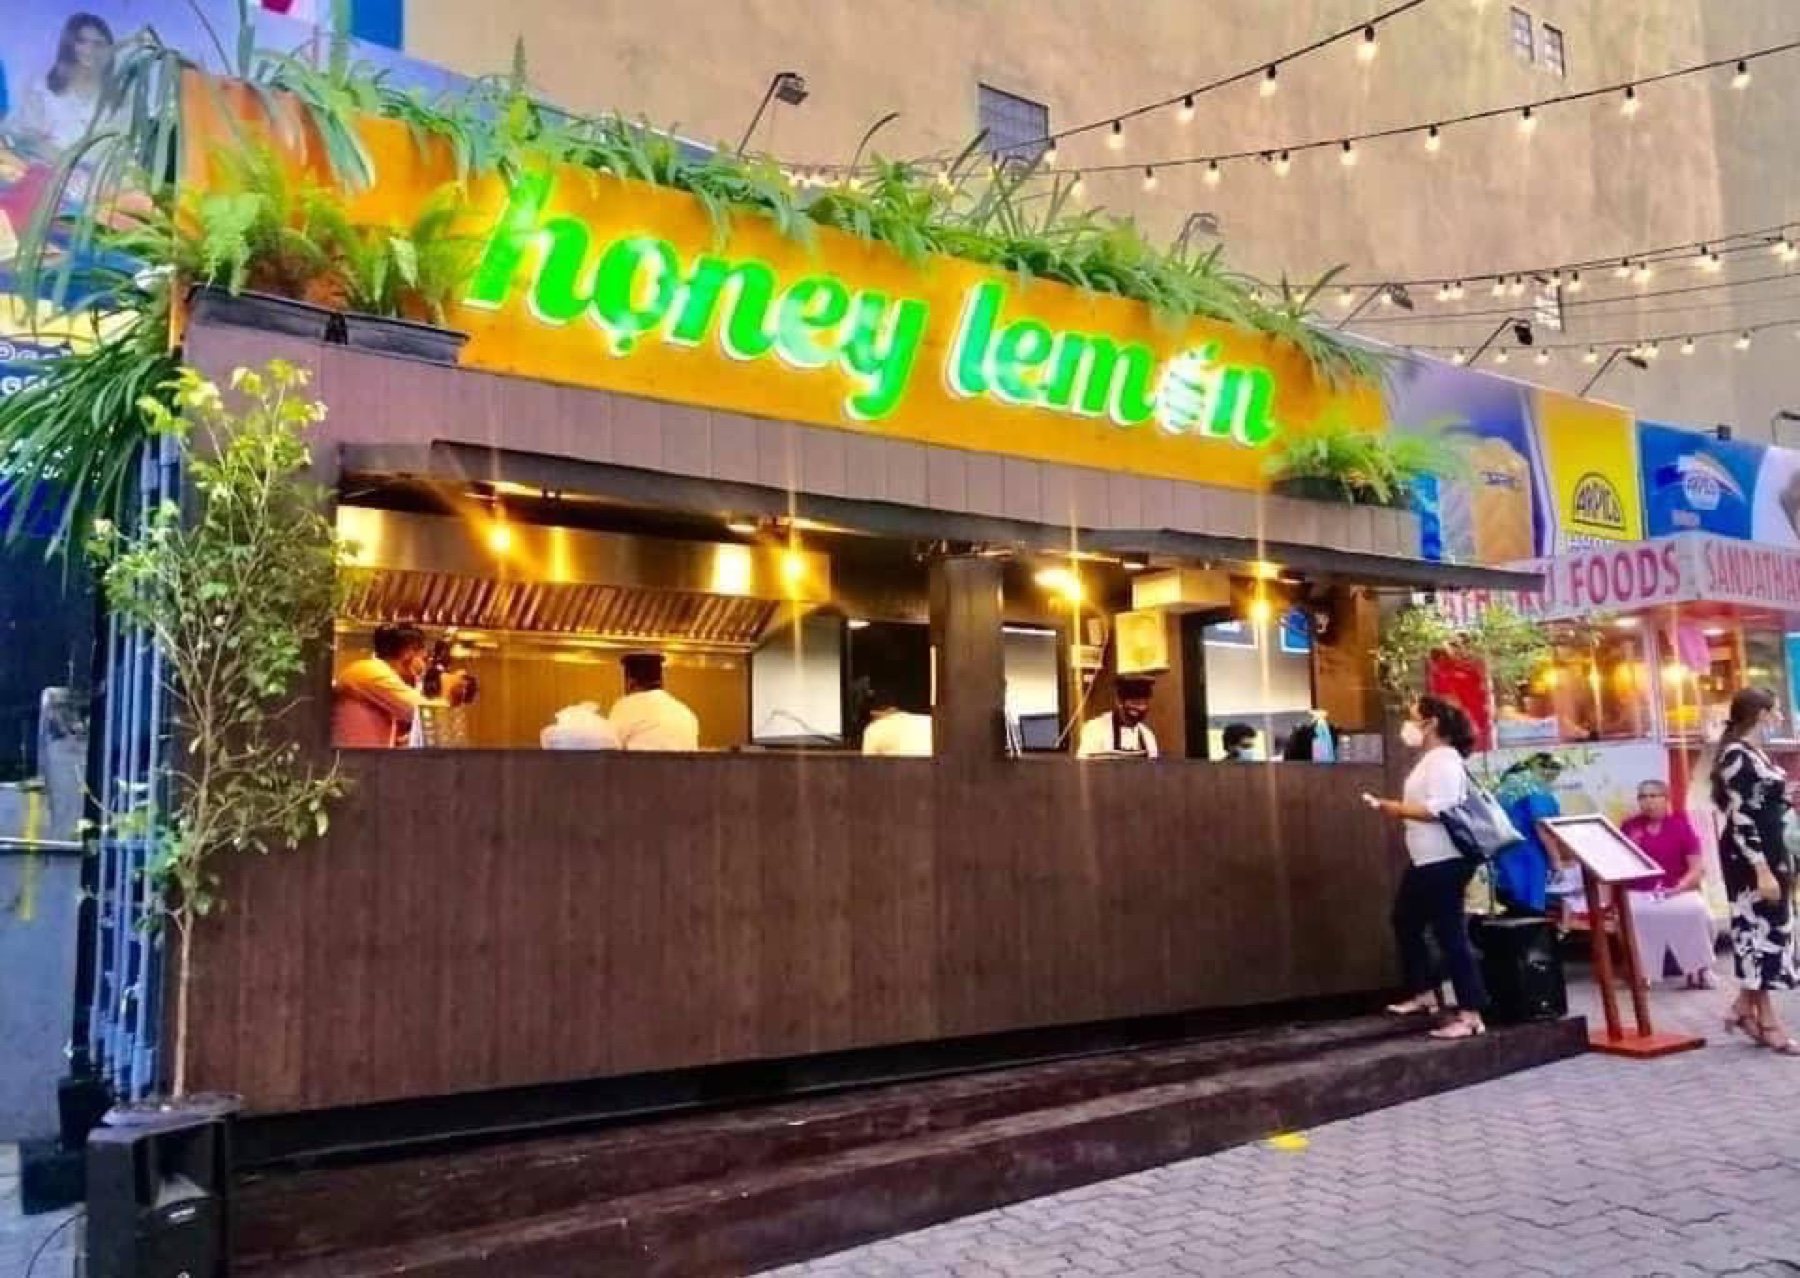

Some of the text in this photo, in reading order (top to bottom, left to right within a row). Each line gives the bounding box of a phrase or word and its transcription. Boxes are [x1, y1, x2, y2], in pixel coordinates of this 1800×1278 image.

[462, 166, 1279, 447] honey lemon
[1567, 542, 1681, 607] FOODS
